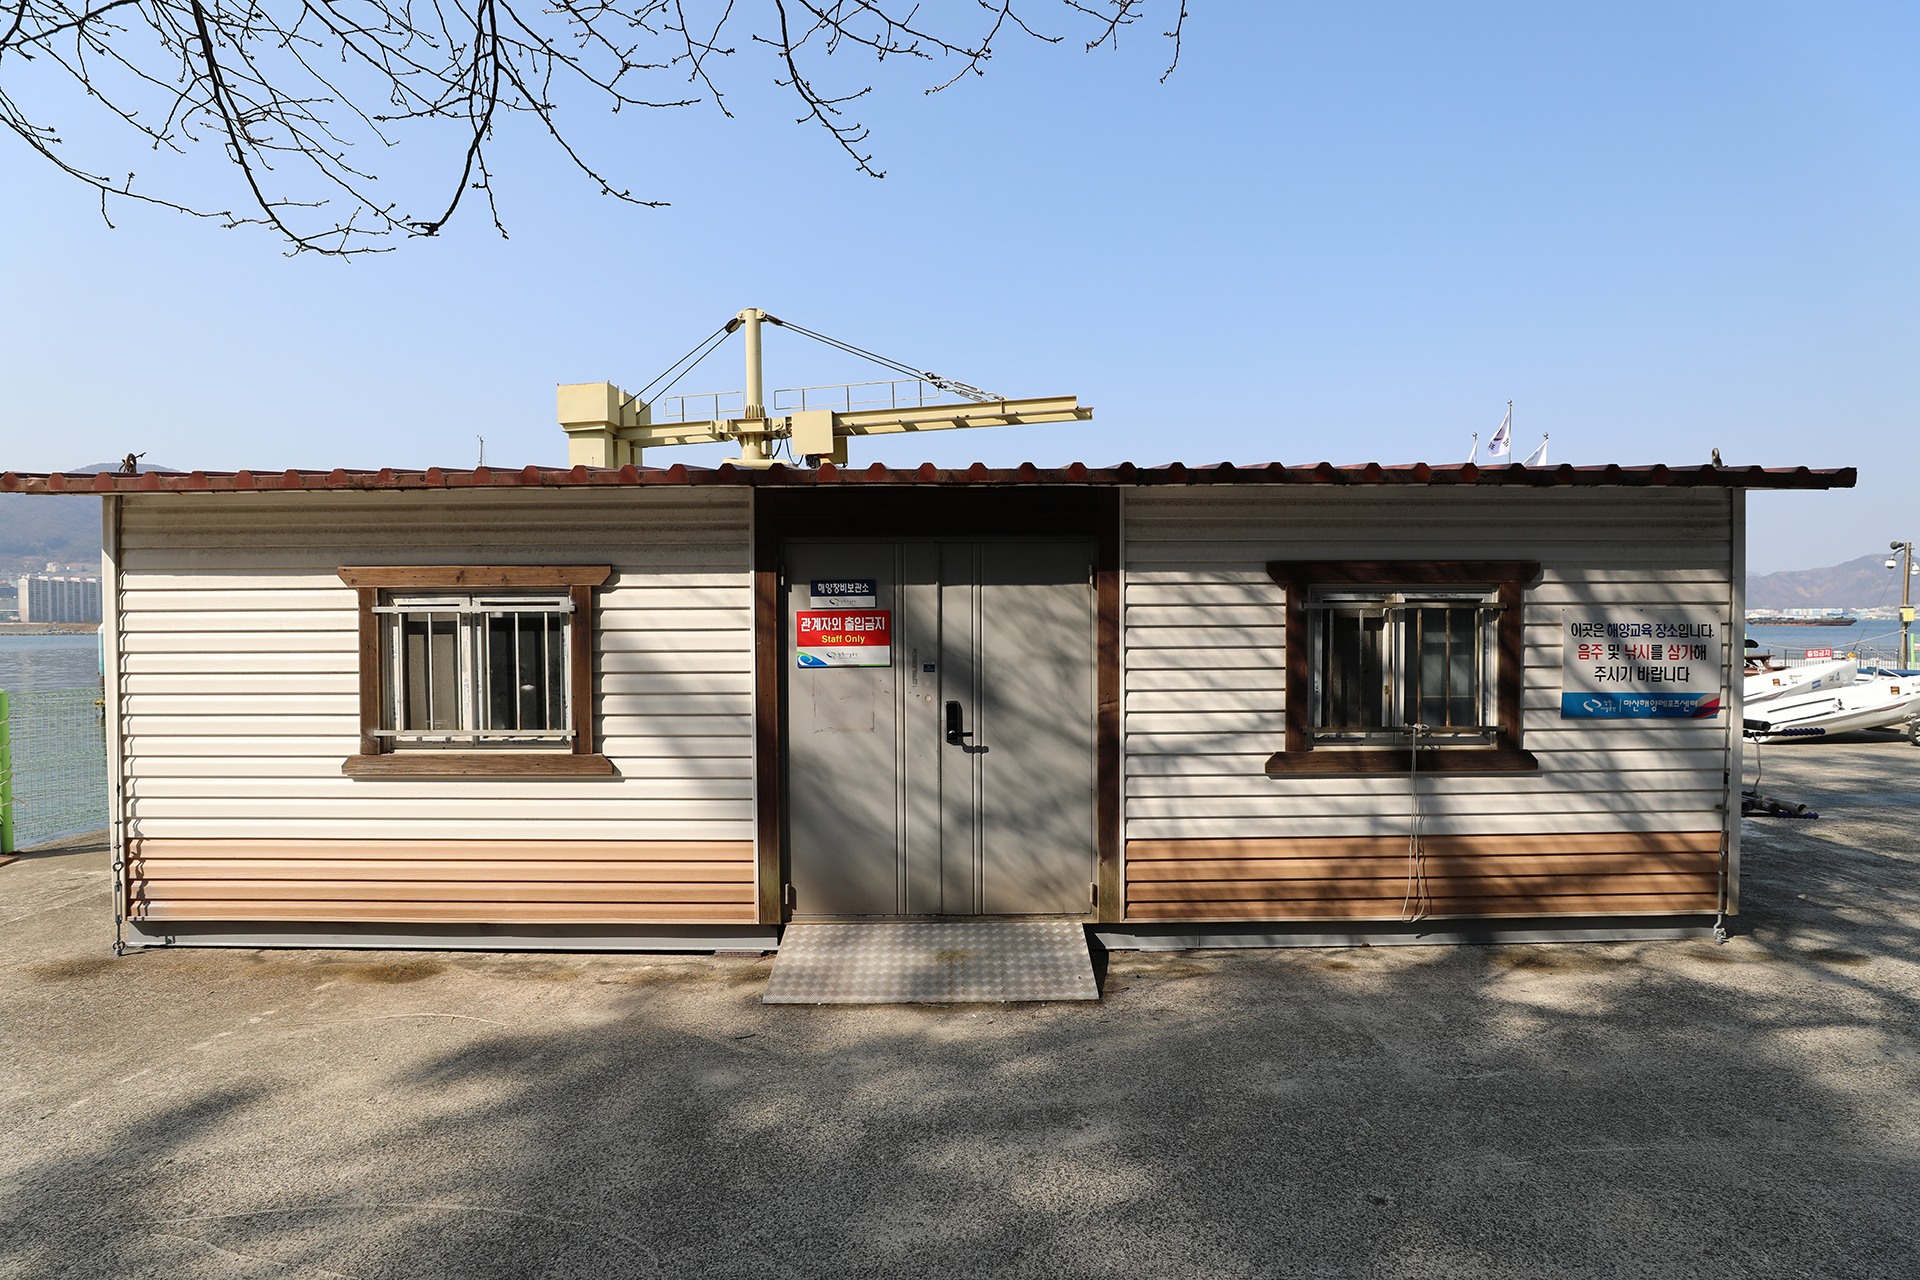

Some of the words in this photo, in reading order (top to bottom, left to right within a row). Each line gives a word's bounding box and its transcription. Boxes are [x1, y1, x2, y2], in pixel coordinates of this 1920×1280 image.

[817, 583, 869, 594] 해양장비보관소
[801, 617, 842, 632] 관계자외
[844, 616, 885, 631] 출입금지
[1571, 623, 1605, 638] 이곳은
[1606, 623, 1652, 639] 해양교육
[1655, 623, 1715, 639] 장소입니다.
[821, 635, 843, 643] Staff
[844, 634, 866, 644] Only
[1577, 643, 1603, 660] 음주
[1607, 644, 1620, 661] 및
[1624, 644, 1663, 661] 낚시를
[1667, 644, 1707, 661] 삼가해
[1594, 666, 1633, 682] 주시기
[1637, 666, 1690, 682] 바랍니다
[1623, 699, 1698, 713] 마산해양레포츠센터
